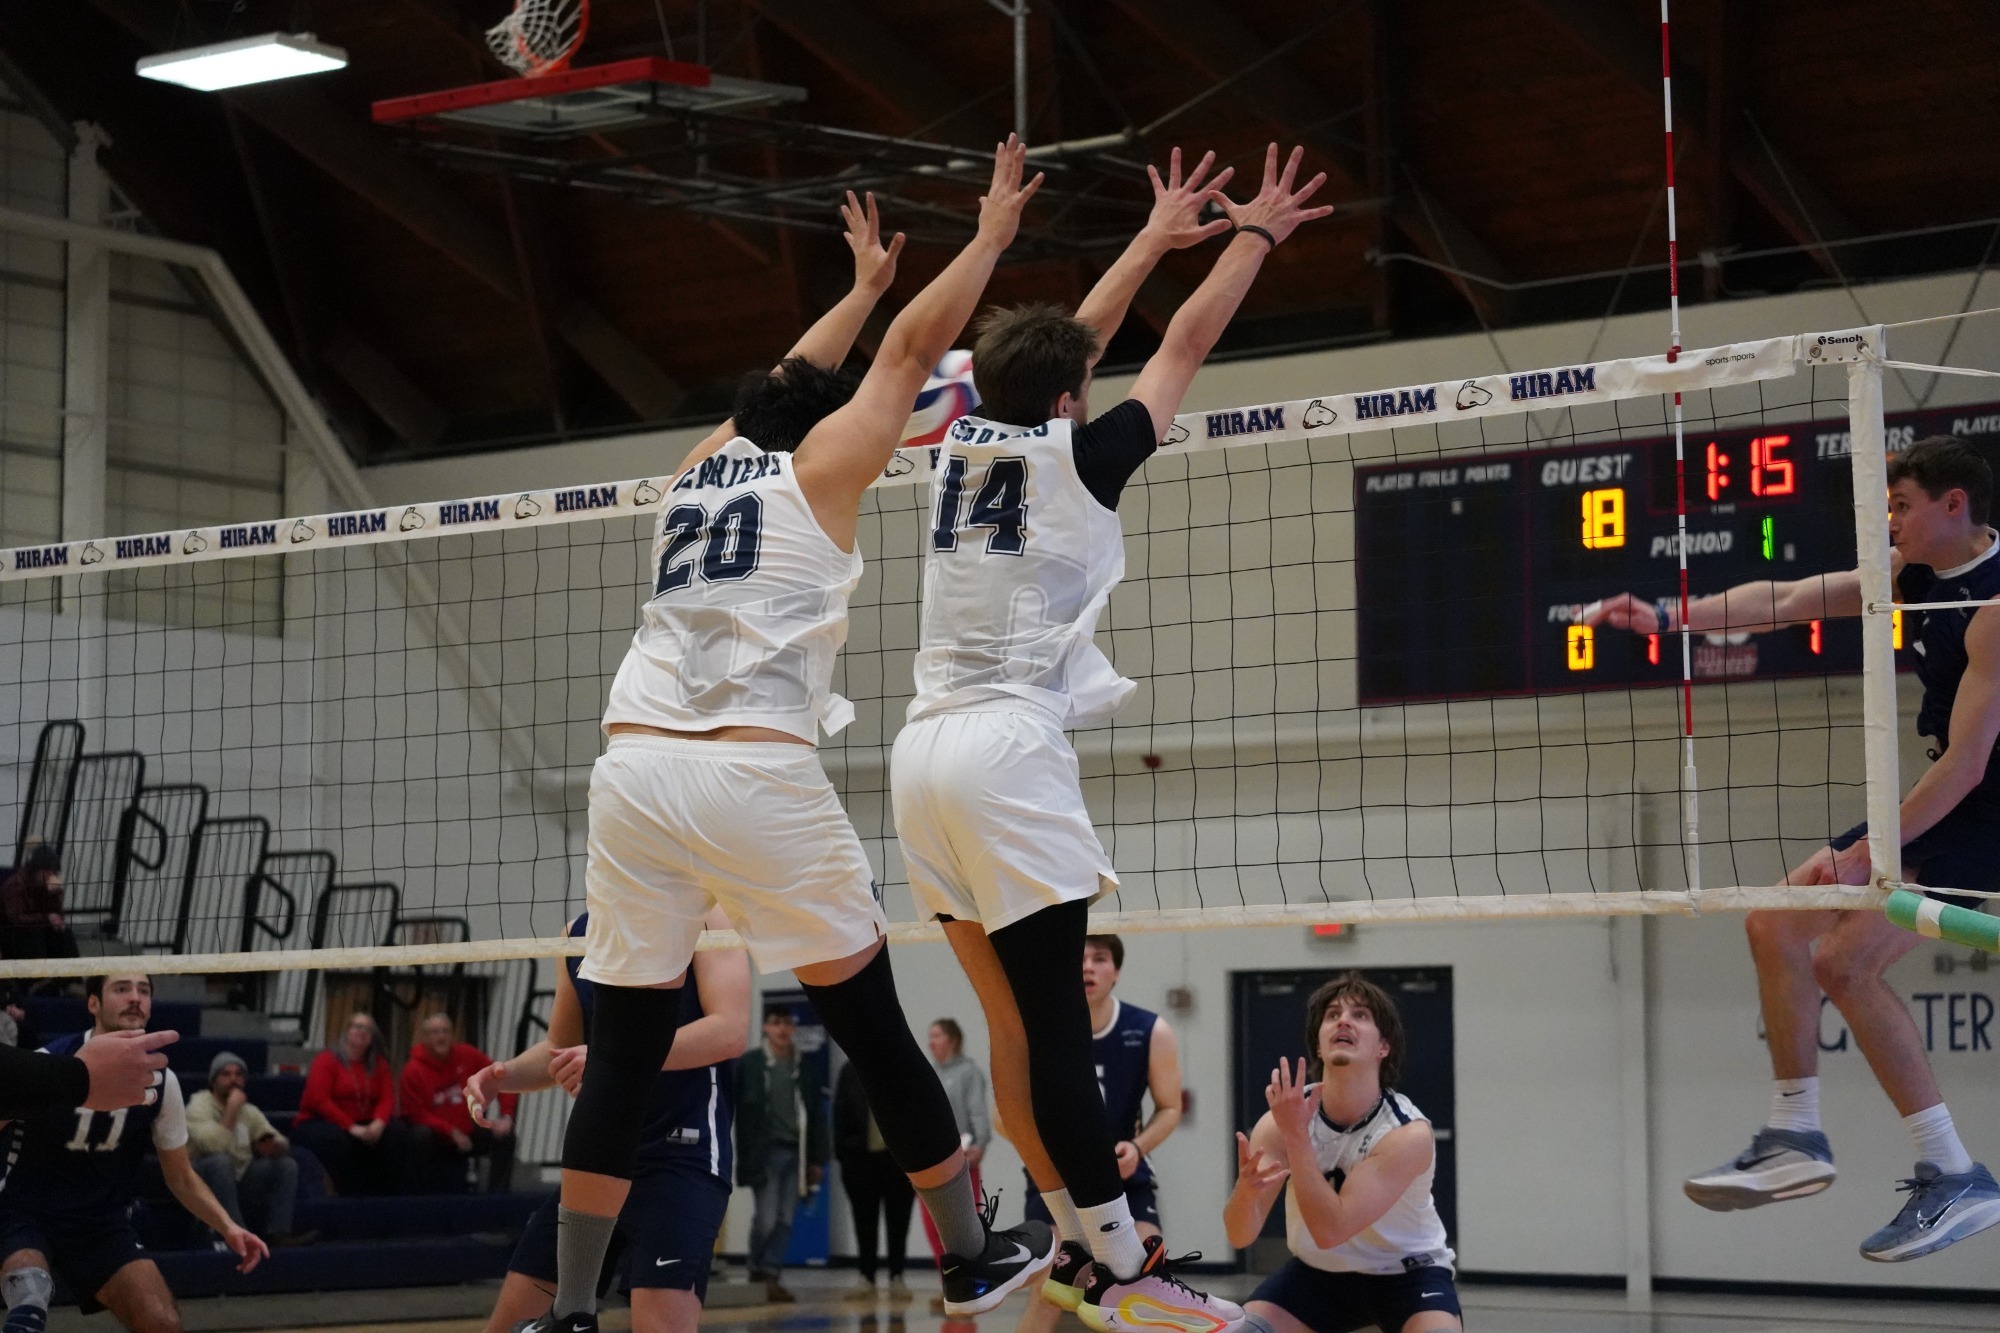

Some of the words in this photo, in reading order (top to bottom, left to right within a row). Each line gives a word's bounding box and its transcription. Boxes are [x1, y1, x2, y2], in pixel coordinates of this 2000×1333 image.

[1827, 334, 1863, 345] Senoh
[15, 547, 69, 570] HIRAM
[116, 535, 171, 559] HIRAM
[220, 524, 276, 549] HIRAM
[327, 512, 387, 538] HIRAM
[439, 500, 501, 525] HIRAM
[554, 486, 618, 512] HIRAM
[1206, 406, 1285, 439] HIRAM
[1355, 387, 1437, 421] HIRAM
[1509, 366, 1596, 401] HIRAM
[1541, 453, 1633, 487] GUEST
[1707, 434, 1794, 501] 1:15
[932, 455, 1029, 557] 14
[1582, 488, 1625, 550] 18
[653, 491, 764, 600] 20
[1567, 625, 1594, 671] 0
[65, 1106, 129, 1151] 11
